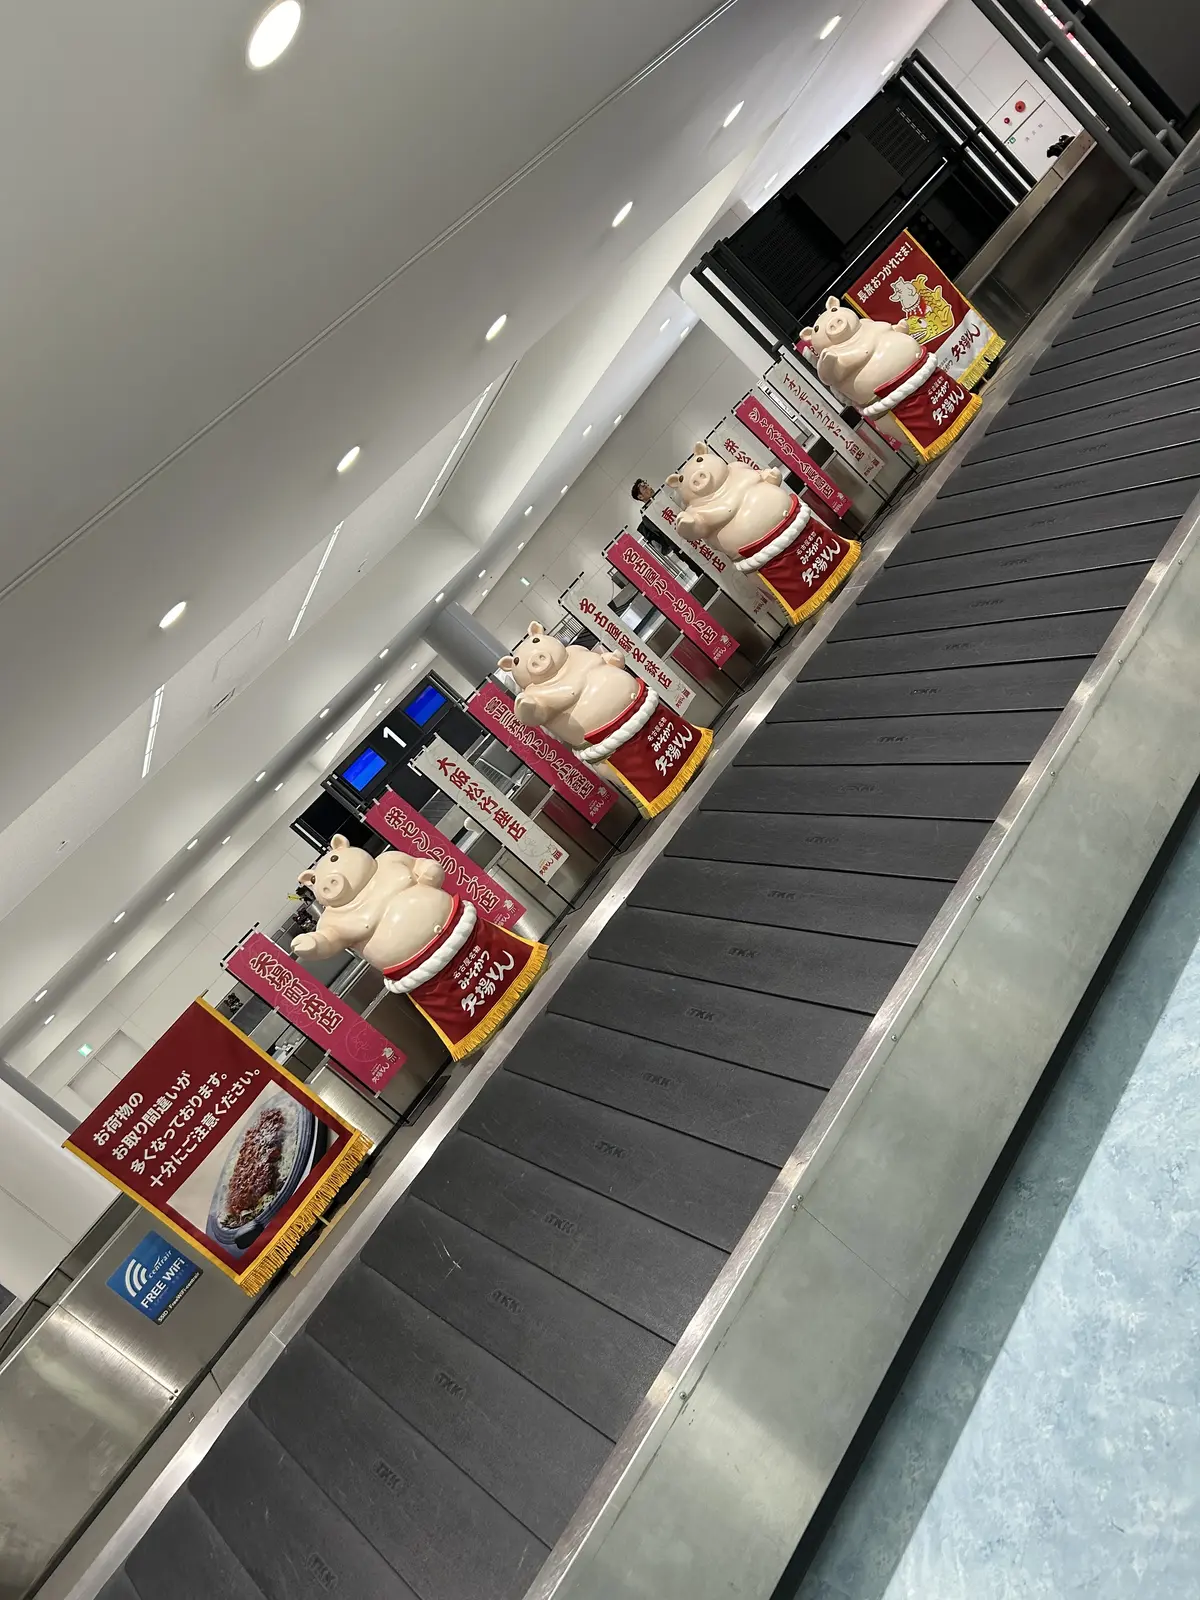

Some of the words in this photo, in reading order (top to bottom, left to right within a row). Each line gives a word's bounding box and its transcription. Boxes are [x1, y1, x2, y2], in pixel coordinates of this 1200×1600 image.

[952, 323, 981, 362] 矢場とん
[783, 373, 865, 461] イオンモールナゴヤドーム前店
[931, 381, 949, 405] みそかつ
[932, 385, 964, 425] 矢場とん
[748, 407, 835, 499] ジャズドリーム長島店
[661, 507, 727, 574] 東銀座店
[800, 536, 823, 565] みそかつ
[802, 538, 840, 587] 矢場とん
[623, 548, 717, 646] 名古屋ルーセント店
[579, 598, 672, 690] 名古屋駅名鉄店
[383, 726, 407, 748] 1
[647, 717, 668, 742] 名古屋名物
[651, 722, 675, 752] みそかつ
[655, 725, 693, 776] 矢場とん
[437, 757, 527, 842] 大阪松竹座店
[384, 806, 500, 913] 栄セントライズ店
[453, 945, 482, 979] 名古屋名物
[458, 950, 490, 990] みそかつ
[461, 950, 515, 1018] 矢場とん
[250, 952, 343, 1034] 矢場町本店
[93, 1091, 144, 1146] お荷物の
[112, 1070, 191, 1160] お取り間違いが
[130, 1072, 228, 1175] 多くなっております。
[150, 1069, 261, 1188] 十分にご注意ください。
[141, 1280, 166, 1309] FREE
[162, 1257, 185, 1281] WiFi
[148, 1250, 172, 1278] centrair
